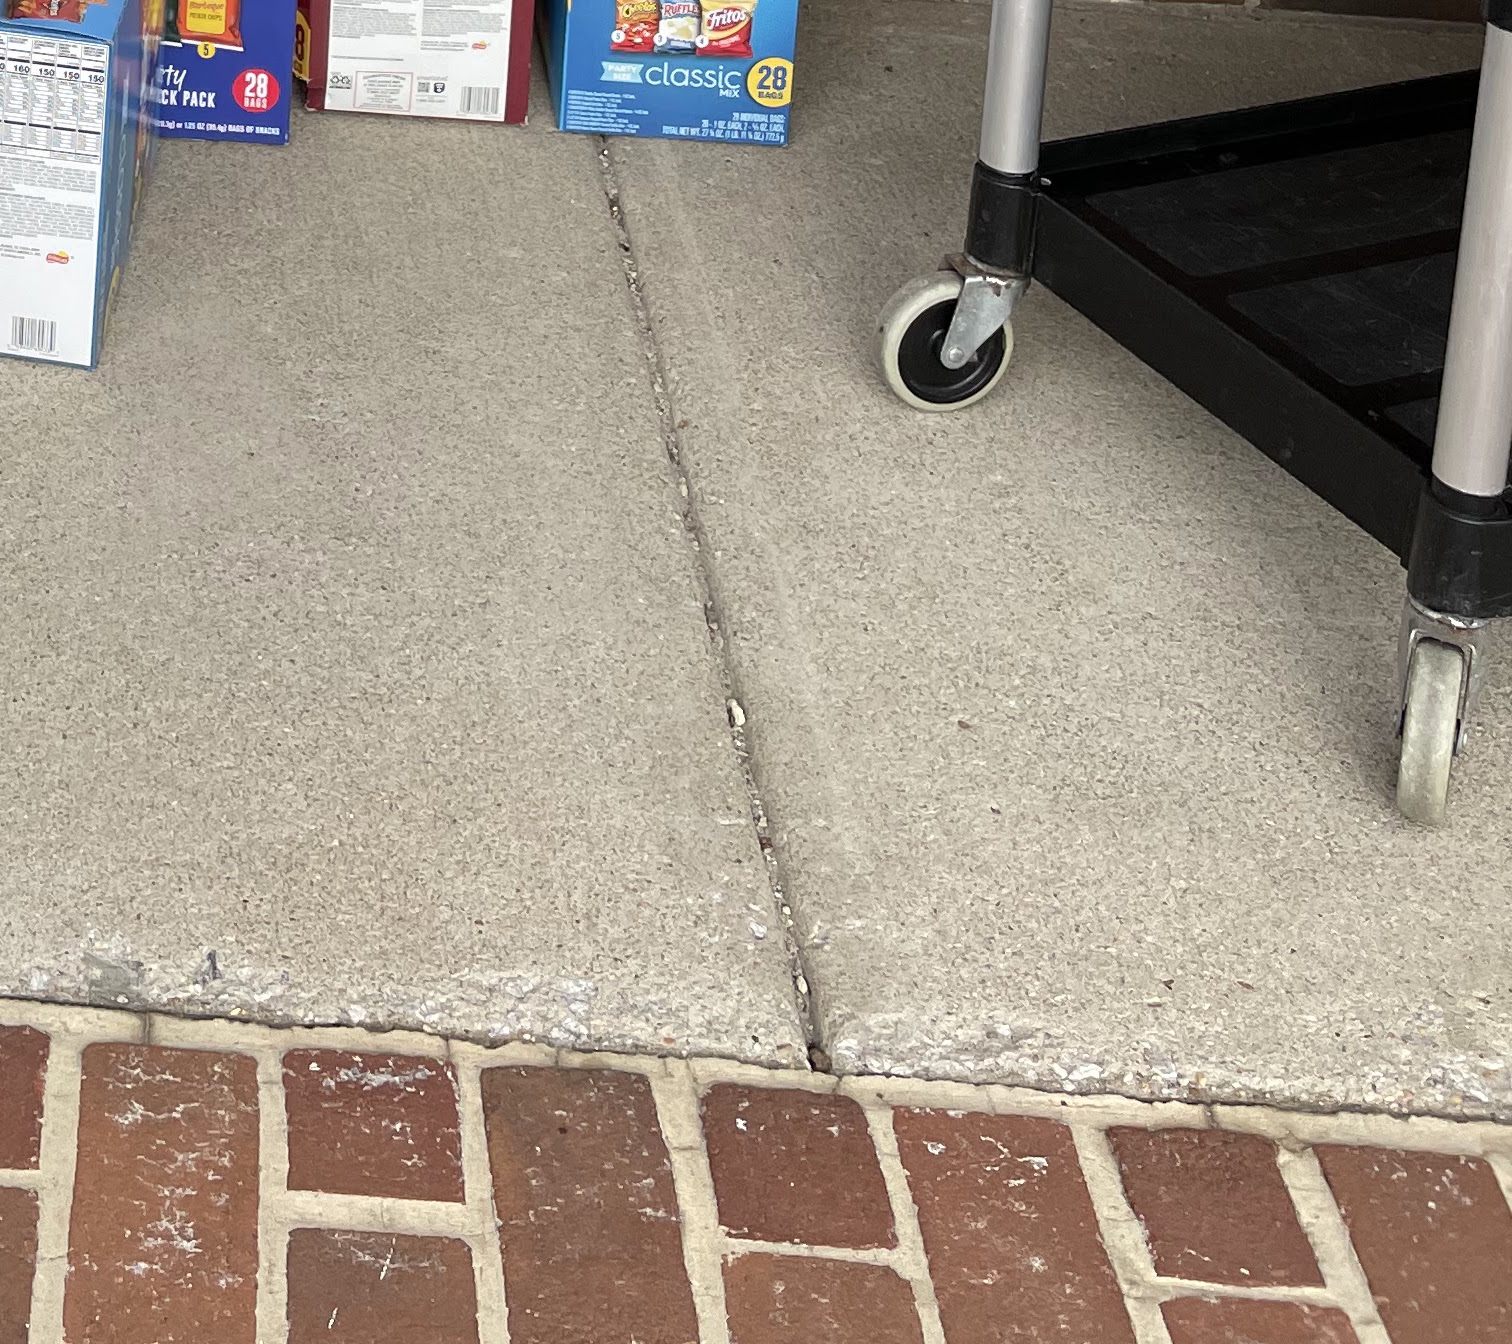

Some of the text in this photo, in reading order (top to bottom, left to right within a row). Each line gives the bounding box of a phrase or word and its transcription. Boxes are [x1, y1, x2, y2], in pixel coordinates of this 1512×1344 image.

[706, 9, 747, 31] Fritos
[203, 43, 209, 56] 5
[244, 72, 269, 98] 28
[645, 62, 742, 90] classic
[756, 65, 787, 91] 28
[182, 90, 216, 108] PACK
[719, 88, 740, 98] MIX
[758, 91, 784, 100] BAGS
[243, 97, 268, 110] BAGS
